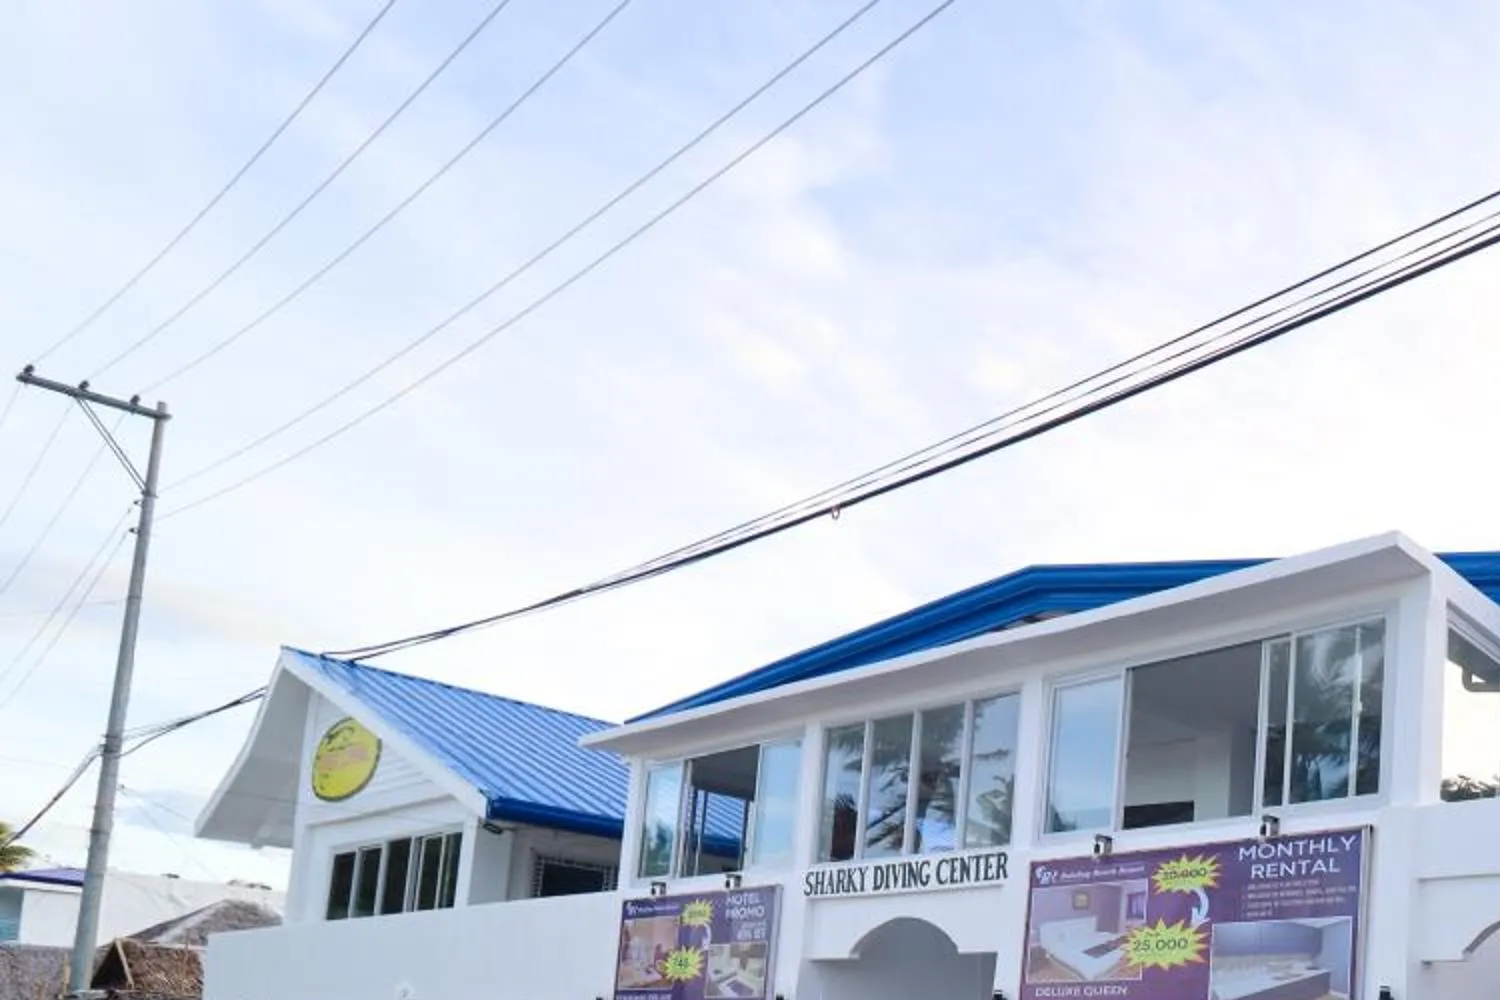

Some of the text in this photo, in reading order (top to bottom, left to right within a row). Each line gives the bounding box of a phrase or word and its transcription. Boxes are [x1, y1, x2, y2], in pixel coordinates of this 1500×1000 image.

[1238, 834, 1358, 861] MONTHLY
[804, 866, 870, 896] SHARKY
[872, 860, 931, 891] DIVING
[936, 852, 1009, 885] CENTER
[1250, 857, 1341, 880] RENTAL
[725, 892, 760, 906] HOTEL
[725, 905, 765, 920] PROMO
[1035, 985, 1128, 998] DELUXE QUEEN
